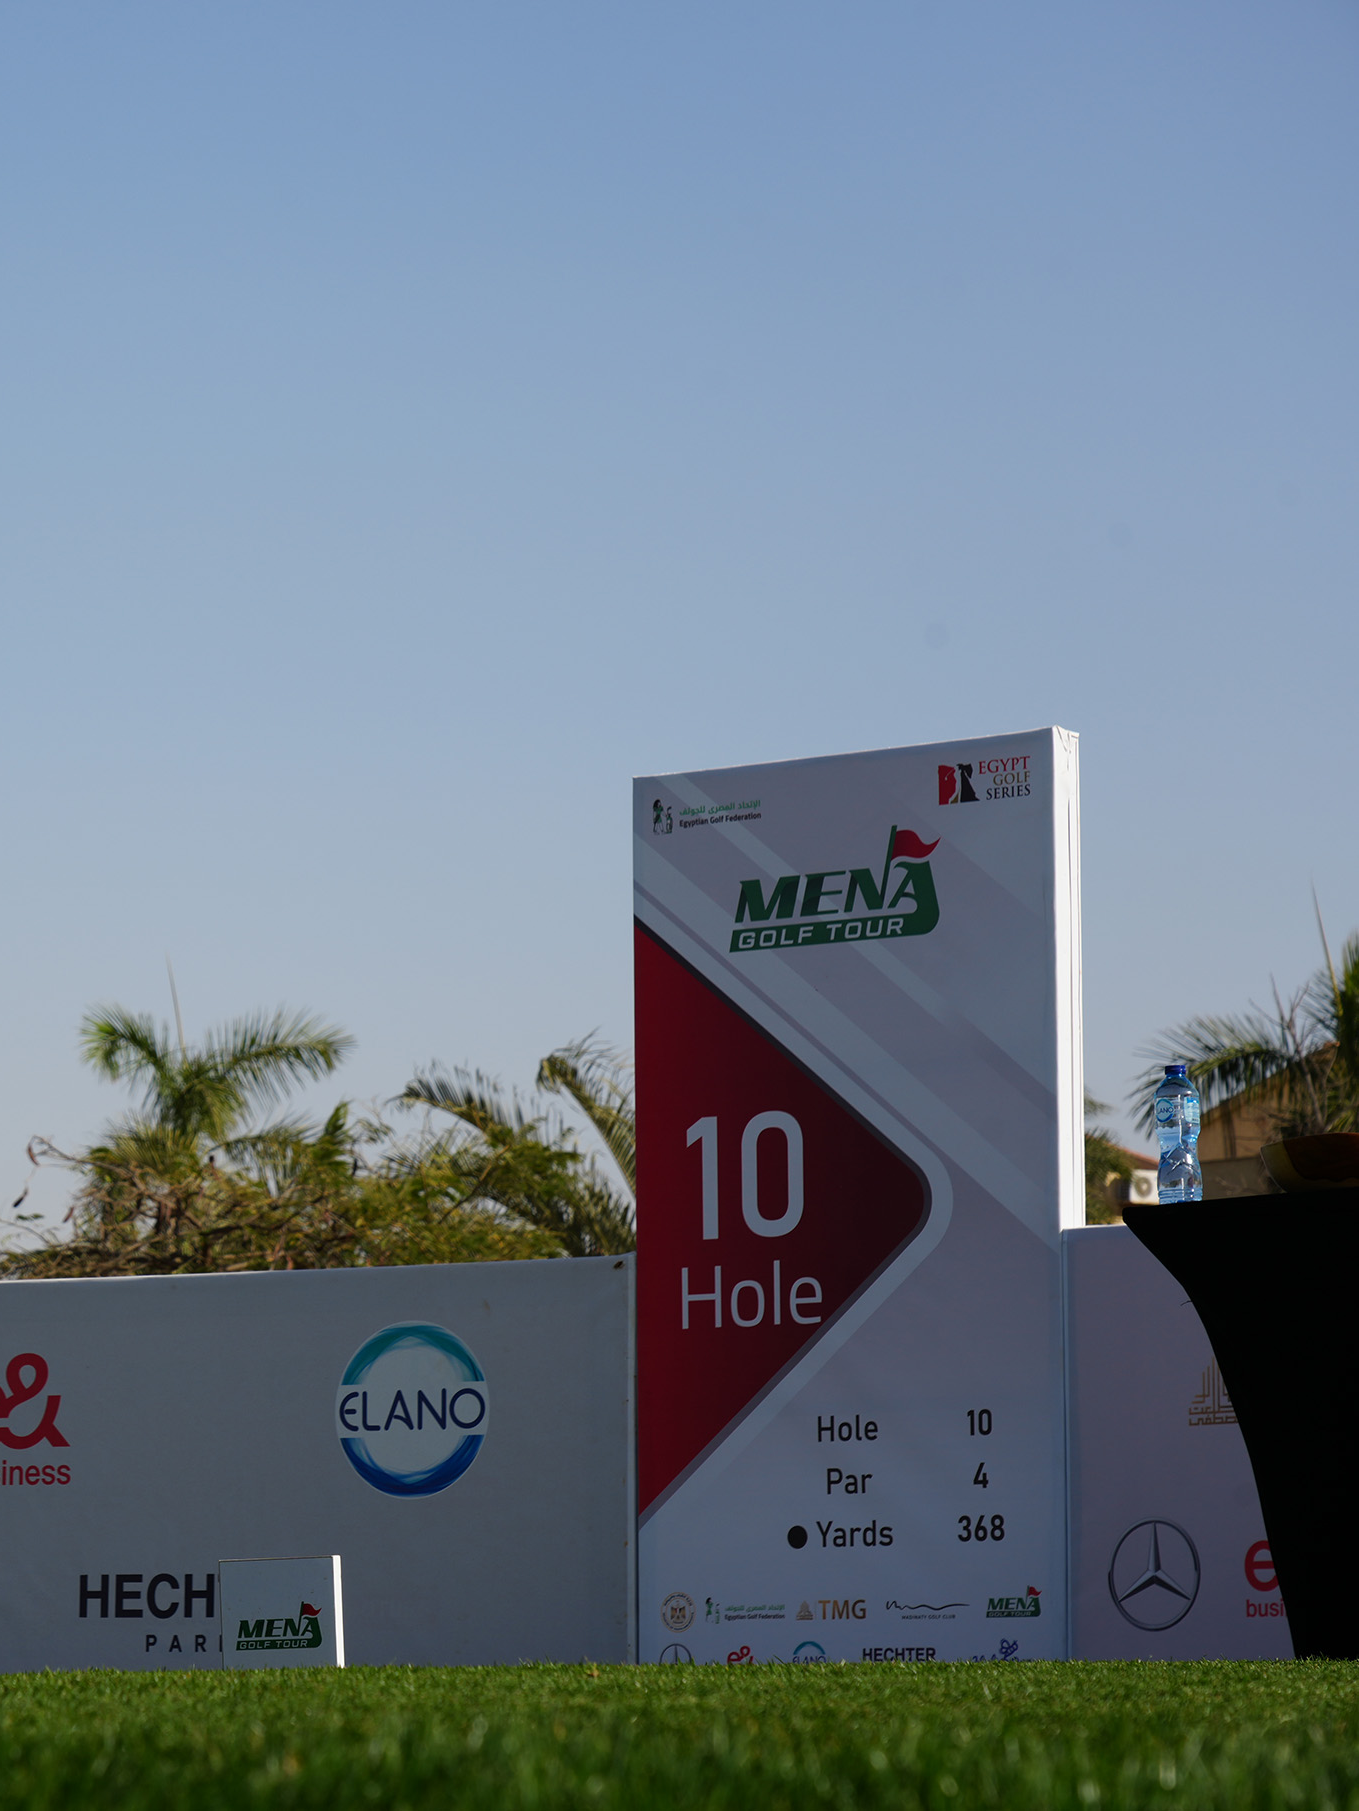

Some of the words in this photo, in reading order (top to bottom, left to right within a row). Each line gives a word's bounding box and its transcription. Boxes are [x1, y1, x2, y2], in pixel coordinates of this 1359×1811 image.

[979, 756, 1031, 775] EGYPT
[993, 771, 1031, 787] GOLF
[986, 784, 1031, 801] SERIES
[679, 817, 709, 829] Egyptian
[710, 815, 724, 825] Golf
[725, 812, 761, 822] Federation
[735, 852, 940, 923] MENA
[738, 926, 814, 949] GOLF
[826, 917, 904, 941] TOUR
[686, 1110, 804, 1240] 10
[681, 1260, 823, 1329] Hole
[339, 1388, 486, 1432] ELANO
[817, 1414, 878, 1442] Hole
[967, 1408, 992, 1436] 10
[826, 1467, 873, 1494] Par
[973, 1462, 989, 1488] 4
[816, 1519, 894, 1547] Yards
[957, 1513, 1005, 1542] 368
[79, 1573, 219, 1619] HECH
[988, 1594, 1041, 1611] MENA
[1246, 1599, 1286, 1618] busi
[818, 1599, 867, 1621] TMG
[238, 1611, 322, 1638] MENA
[239, 1641, 271, 1650] GOLF
[276, 1640, 308, 1648] TOUR
[862, 1647, 937, 1662] HECHTER
